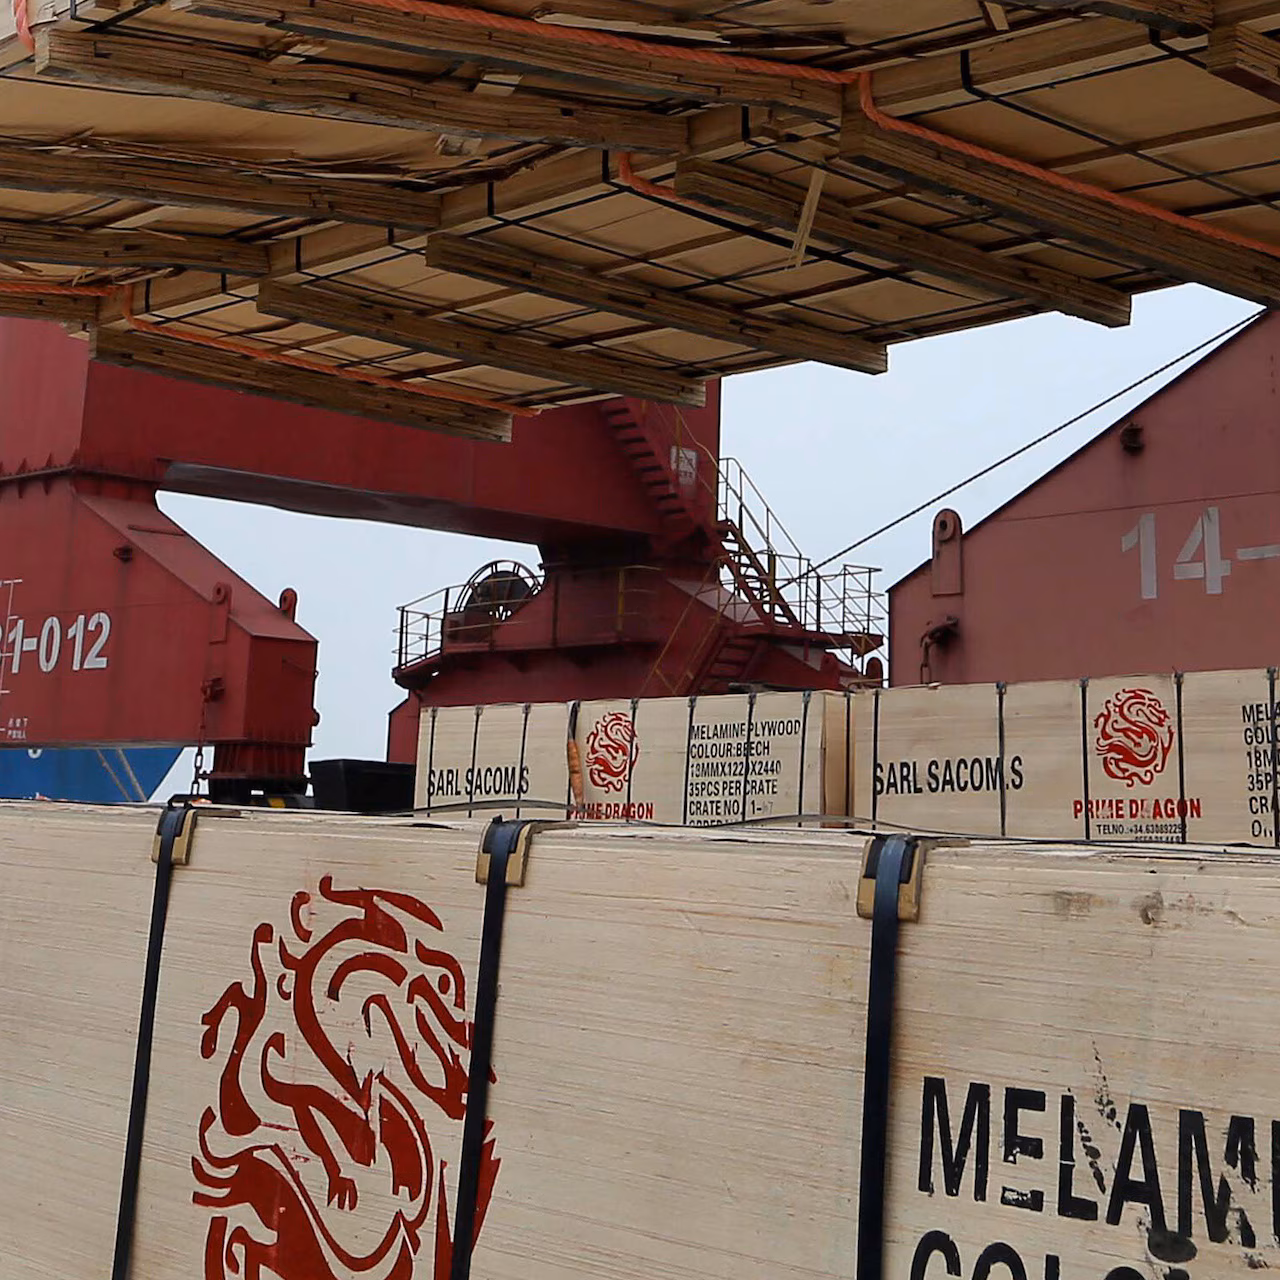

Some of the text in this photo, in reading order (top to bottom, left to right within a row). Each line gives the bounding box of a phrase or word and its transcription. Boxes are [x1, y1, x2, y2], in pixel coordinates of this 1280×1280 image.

[749, 719, 801, 737] PLYWOOD
[874, 755, 1024, 796] SARL SACOM.S
[689, 779, 778, 797] 35PCS PER CRATE
[689, 800, 722, 816] CRATE
